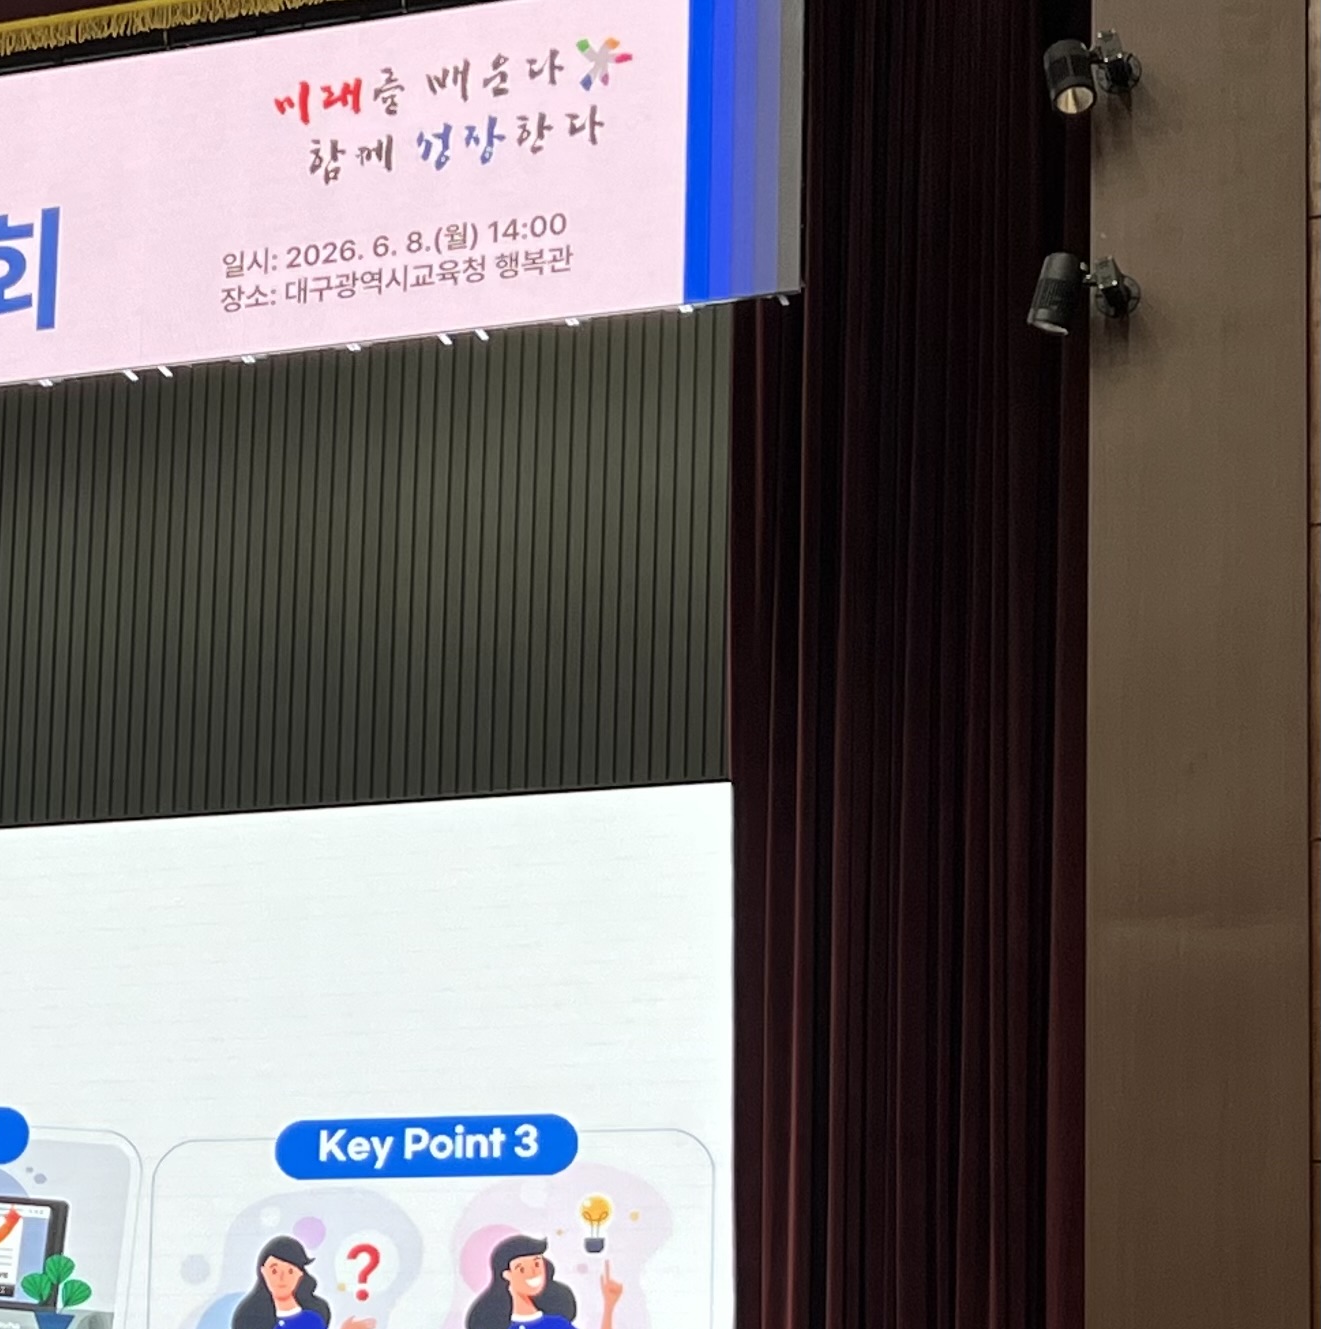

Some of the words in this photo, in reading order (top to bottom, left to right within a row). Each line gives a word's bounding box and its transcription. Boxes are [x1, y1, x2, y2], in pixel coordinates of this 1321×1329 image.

[274, 67, 405, 124] 미래를
[309, 134, 394, 185] 함께
[416, 105, 605, 170] 성장한다
[221, 283, 277, 313] 장소:
[285, 255, 486, 305] 대구광역시교육청
[495, 244, 573, 278] 행복관
[222, 248, 278, 279] 일시:
[286, 239, 364, 270] 2026.
[372, 234, 398, 258] 6.
[407, 221, 479, 256] 8.(월)
[488, 212, 568, 243] 14:00
[317, 1128, 395, 1170] Key
[403, 1124, 506, 1160] Point
[513, 1123, 540, 1159] 3
